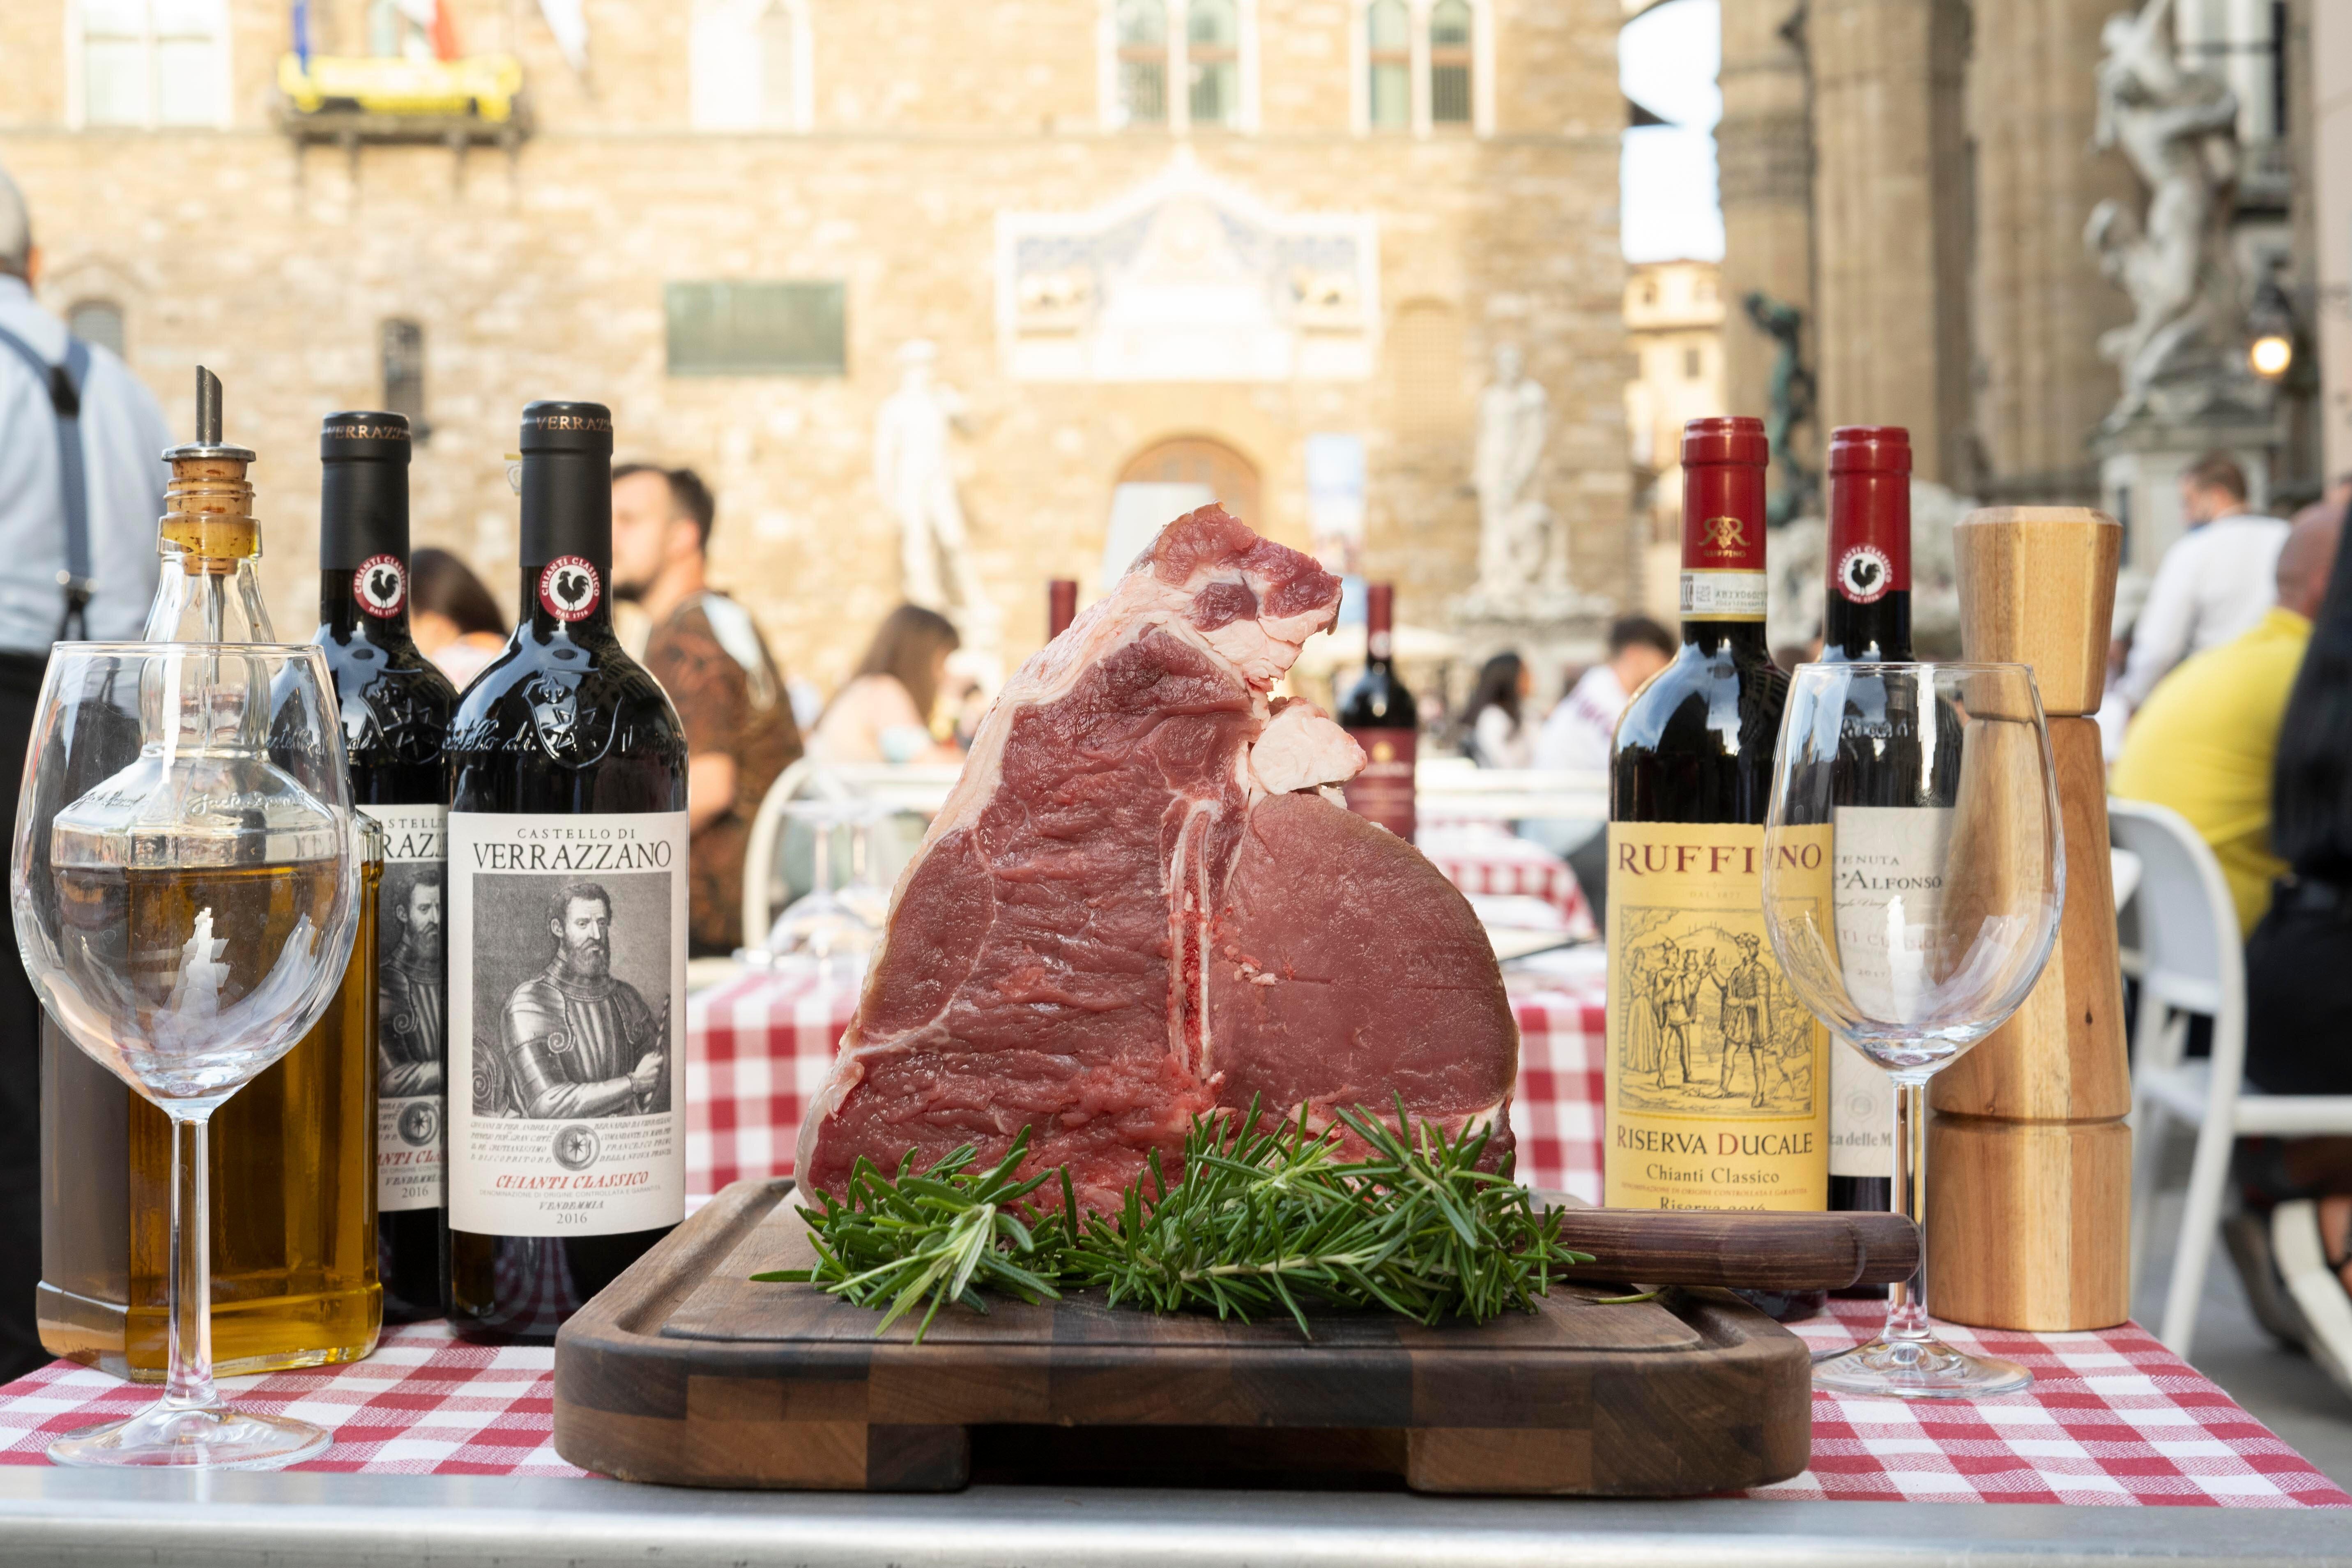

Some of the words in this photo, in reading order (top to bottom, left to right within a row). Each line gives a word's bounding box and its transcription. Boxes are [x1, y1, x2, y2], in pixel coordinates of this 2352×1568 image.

[354, 556, 381, 594] CHIANTI
[384, 556, 406, 594] CLASSICO
[541, 558, 568, 596] CHIANTI
[572, 557, 600, 596] CLASSICO
[369, 606, 383, 615] DAL
[555, 609, 569, 618] DAL
[573, 610, 588, 619] 1716
[517, 829, 610, 839] CASTELLO
[618, 829, 635, 839] DI
[473, 840, 671, 870] VERRAZZANO
[1619, 843, 1822, 875] RUFFINO
[1618, 1125, 1708, 1154] RISERVA
[1718, 1132, 1813, 1156] DUCALE
[1846, 1132, 1878, 1147] delle
[496, 1175, 569, 1189] CHIANTI
[573, 1171, 649, 1189] CLASSICO
[1647, 1164, 1703, 1182] Chianti
[1712, 1167, 1780, 1184] Classico
[402, 1185, 428, 1198] 2016
[575, 1190, 624, 1198] CONTROLLATA
[539, 1200, 604, 1210] VENDEMMIA
[557, 1213, 587, 1224] 2016
